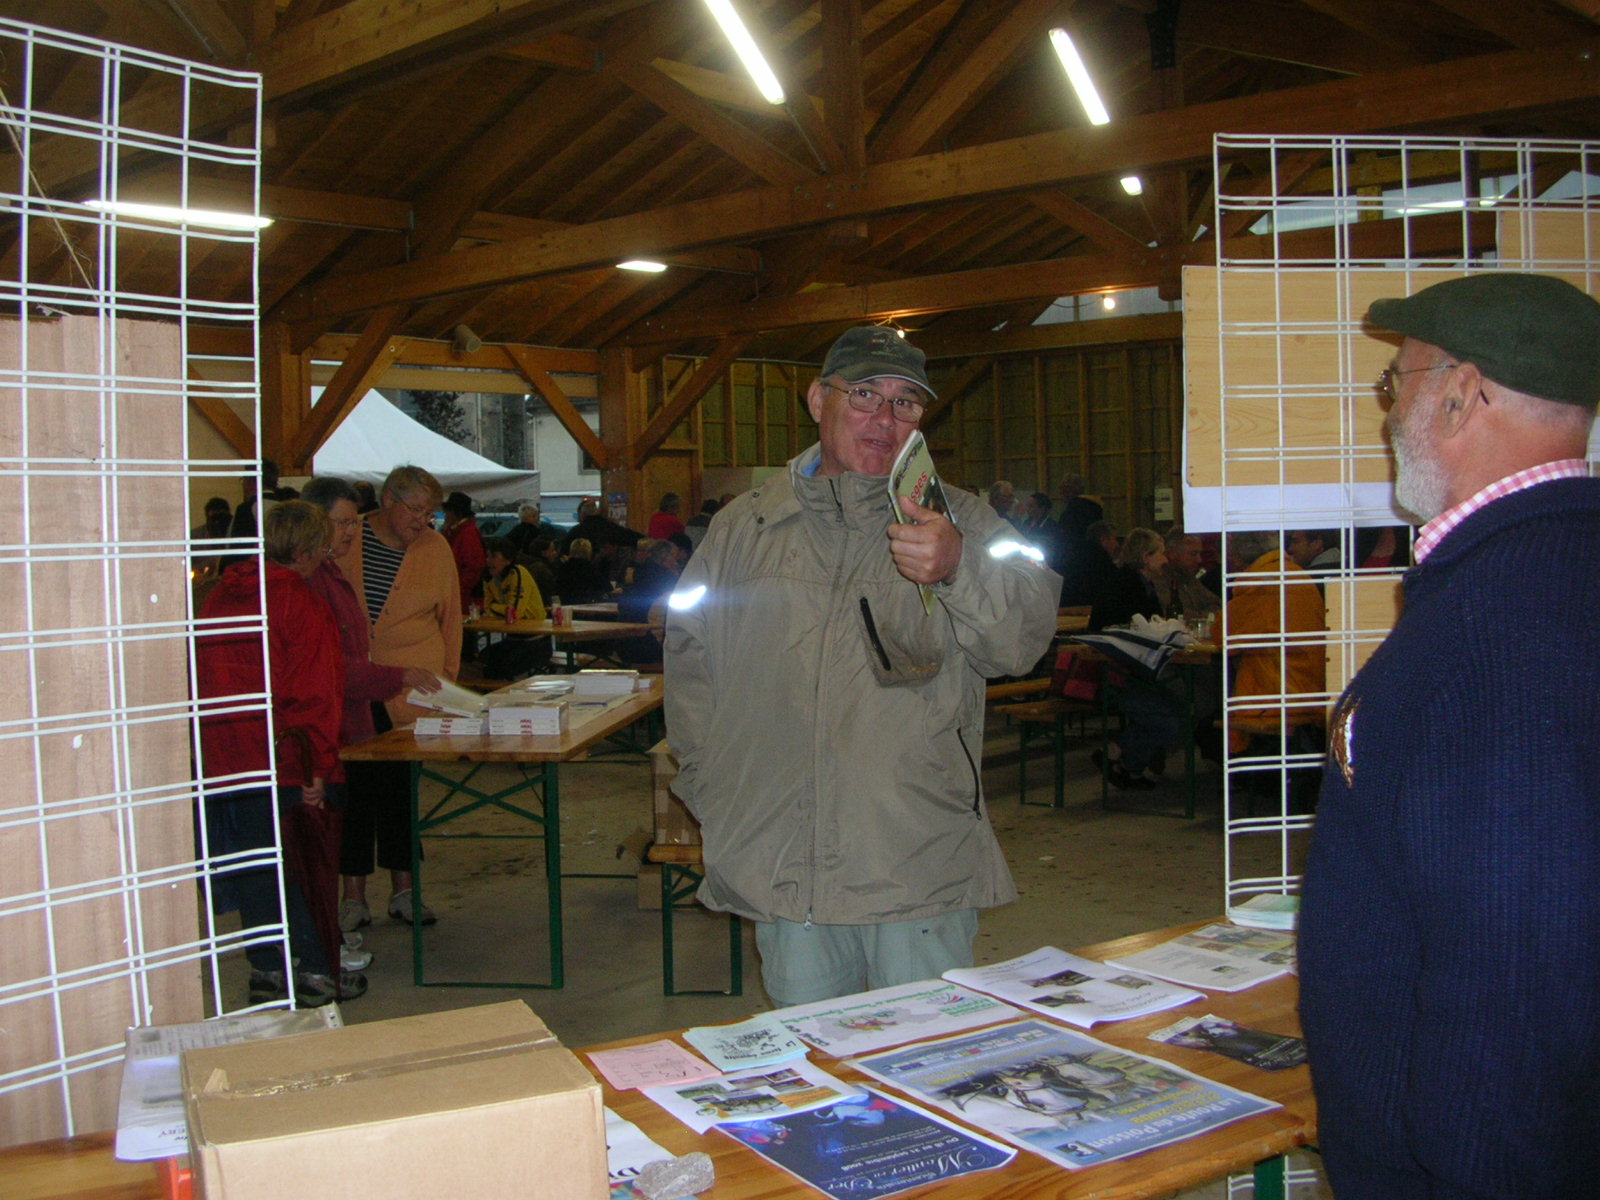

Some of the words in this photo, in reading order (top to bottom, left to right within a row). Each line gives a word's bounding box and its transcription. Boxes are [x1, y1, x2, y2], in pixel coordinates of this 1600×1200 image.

[1171, 1104, 1226, 1122] Route
[1152, 1118, 1174, 1129] du
[1087, 1125, 1161, 1148] Poisson
[891, 1146, 986, 1175] Montier
